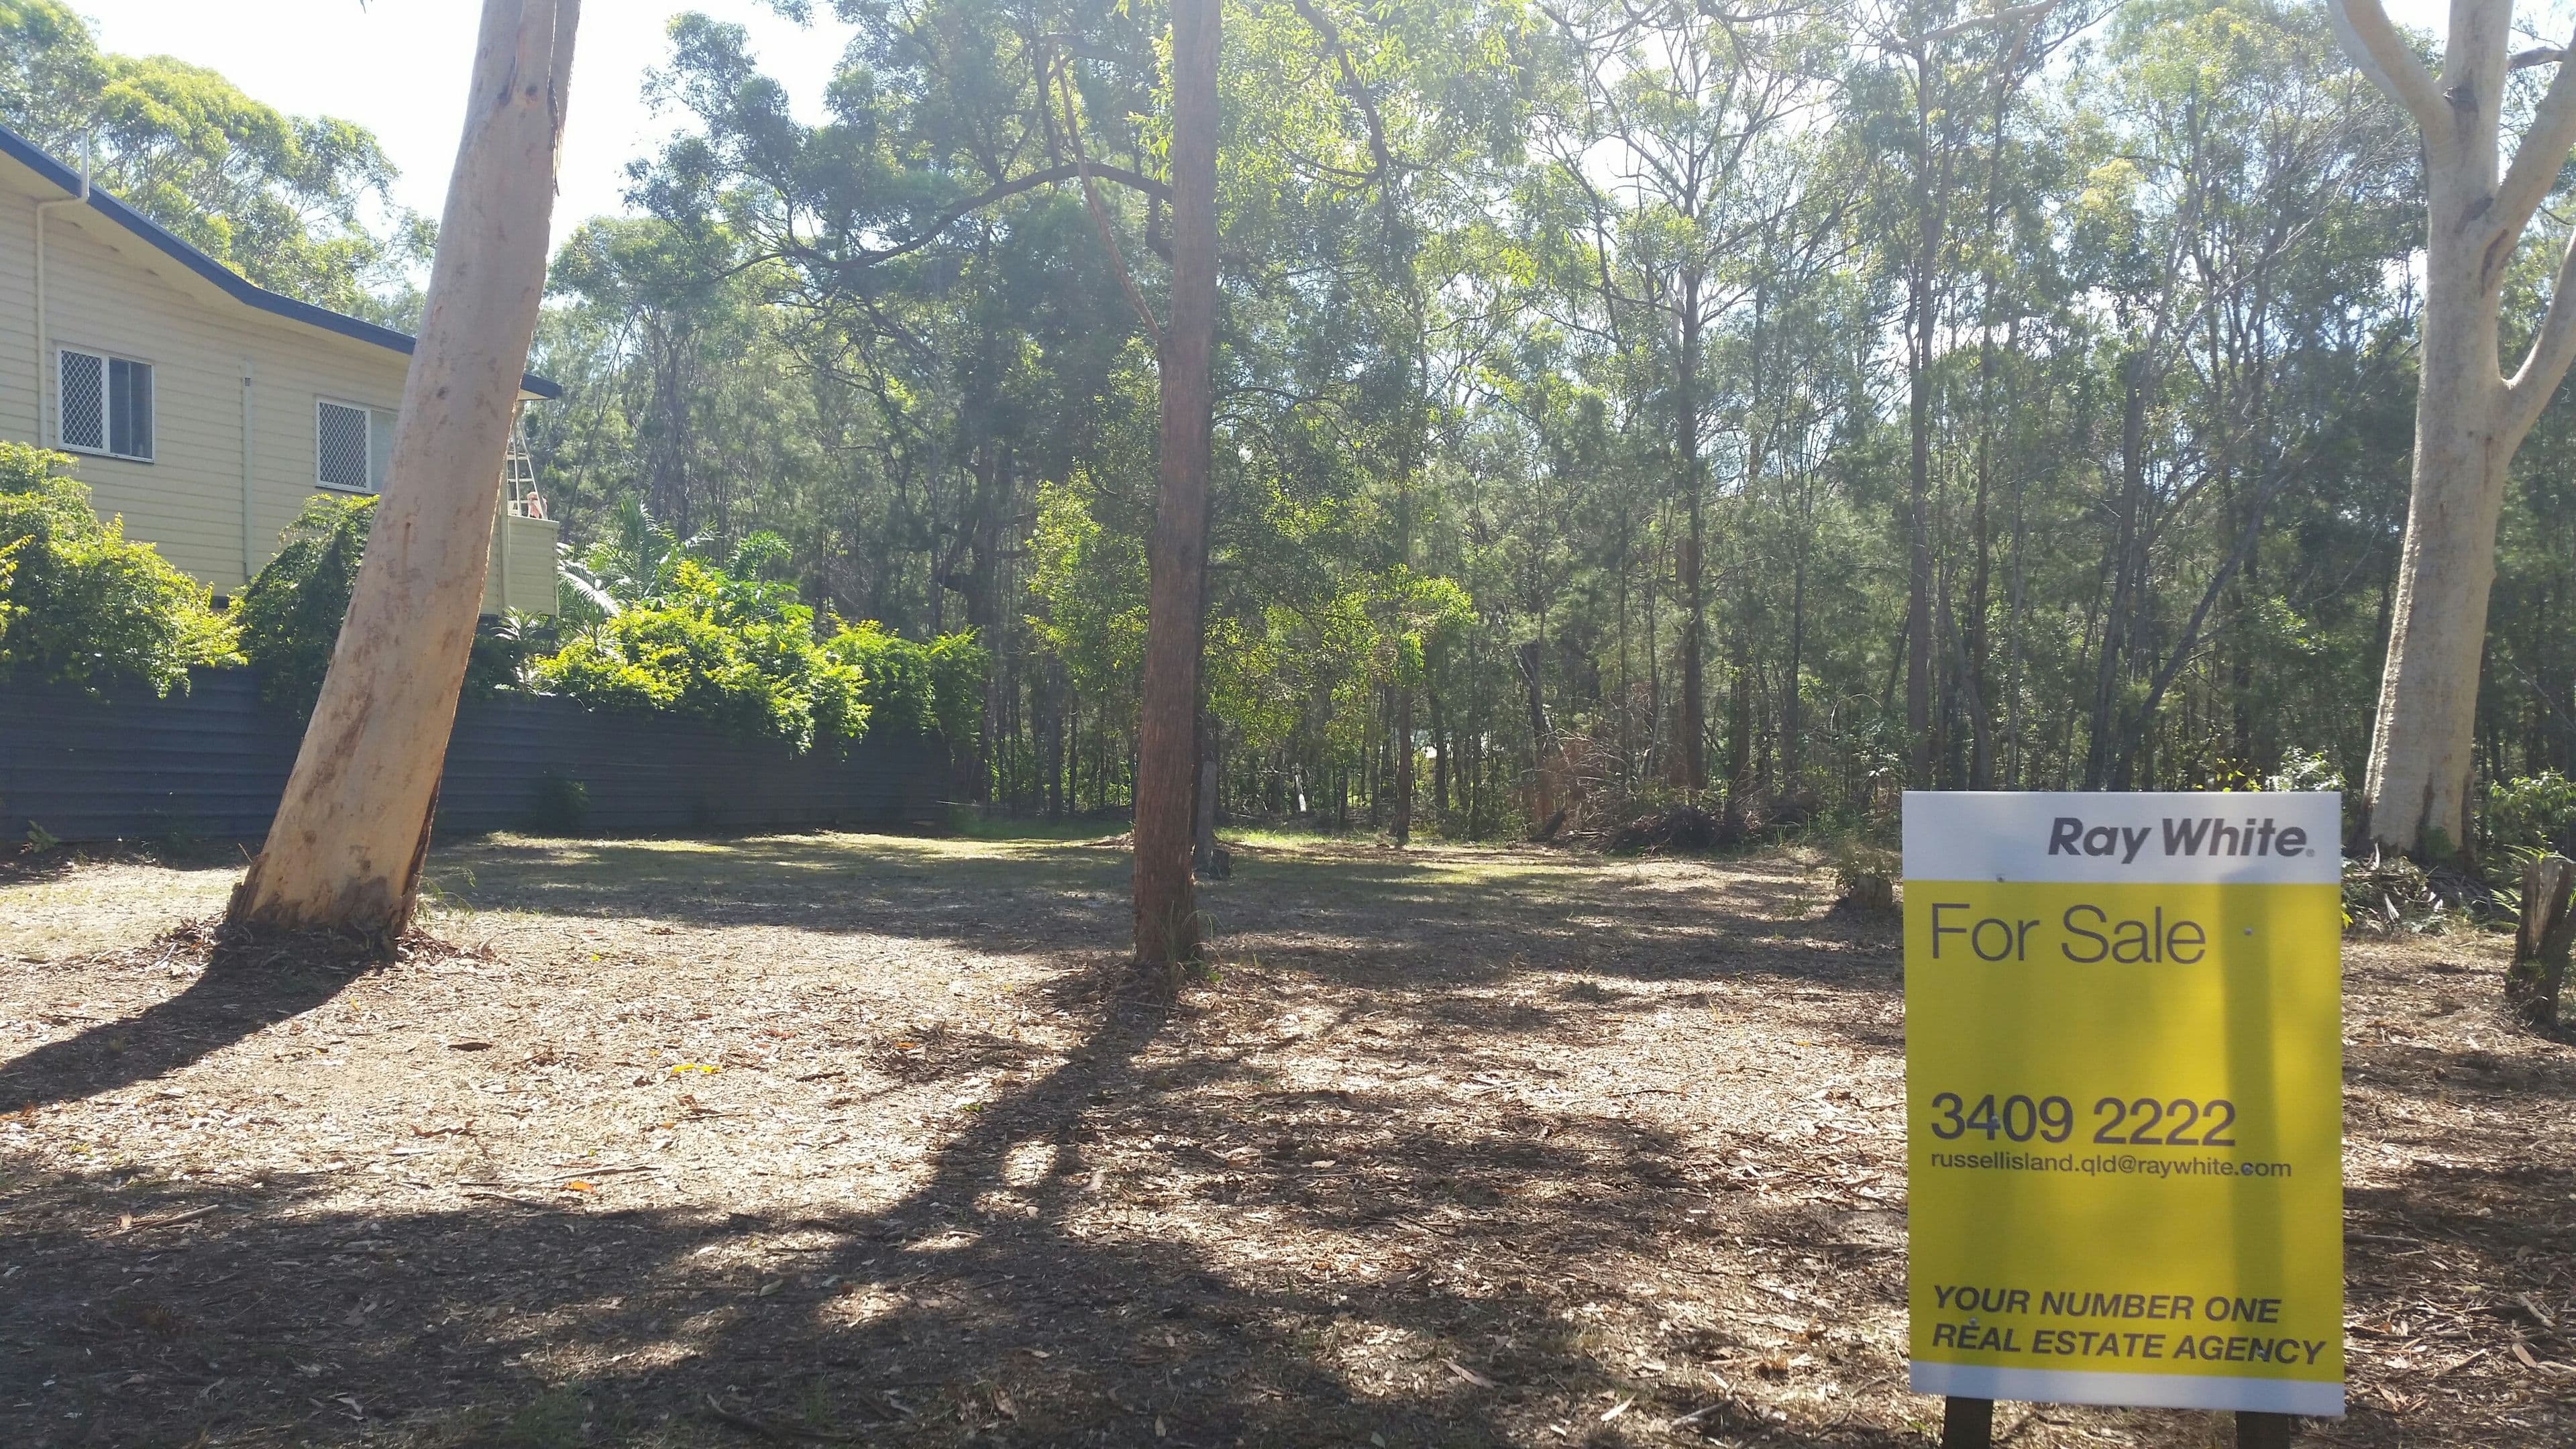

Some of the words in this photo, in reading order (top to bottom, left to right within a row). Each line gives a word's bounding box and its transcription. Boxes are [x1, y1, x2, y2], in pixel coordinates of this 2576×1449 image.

[2048, 817, 2151, 864] Ray
[1932, 903, 2040, 961] For
[2061, 904, 2206, 964] Sale
[1931, 1092, 2074, 1143] 3409
[2092, 1097, 2236, 1146] 2222
[1931, 1151, 2292, 1179] russellisland.qld@raywhite.com
[1934, 1285, 2030, 1314] YOUR
[2040, 1291, 2194, 1320] NUMBER
[2205, 1297, 2282, 1324] ONE
[1933, 1324, 2021, 1353] REAL
[2031, 1330, 2165, 1358] ESTATE
[2172, 1336, 2326, 1364] AGENCY
